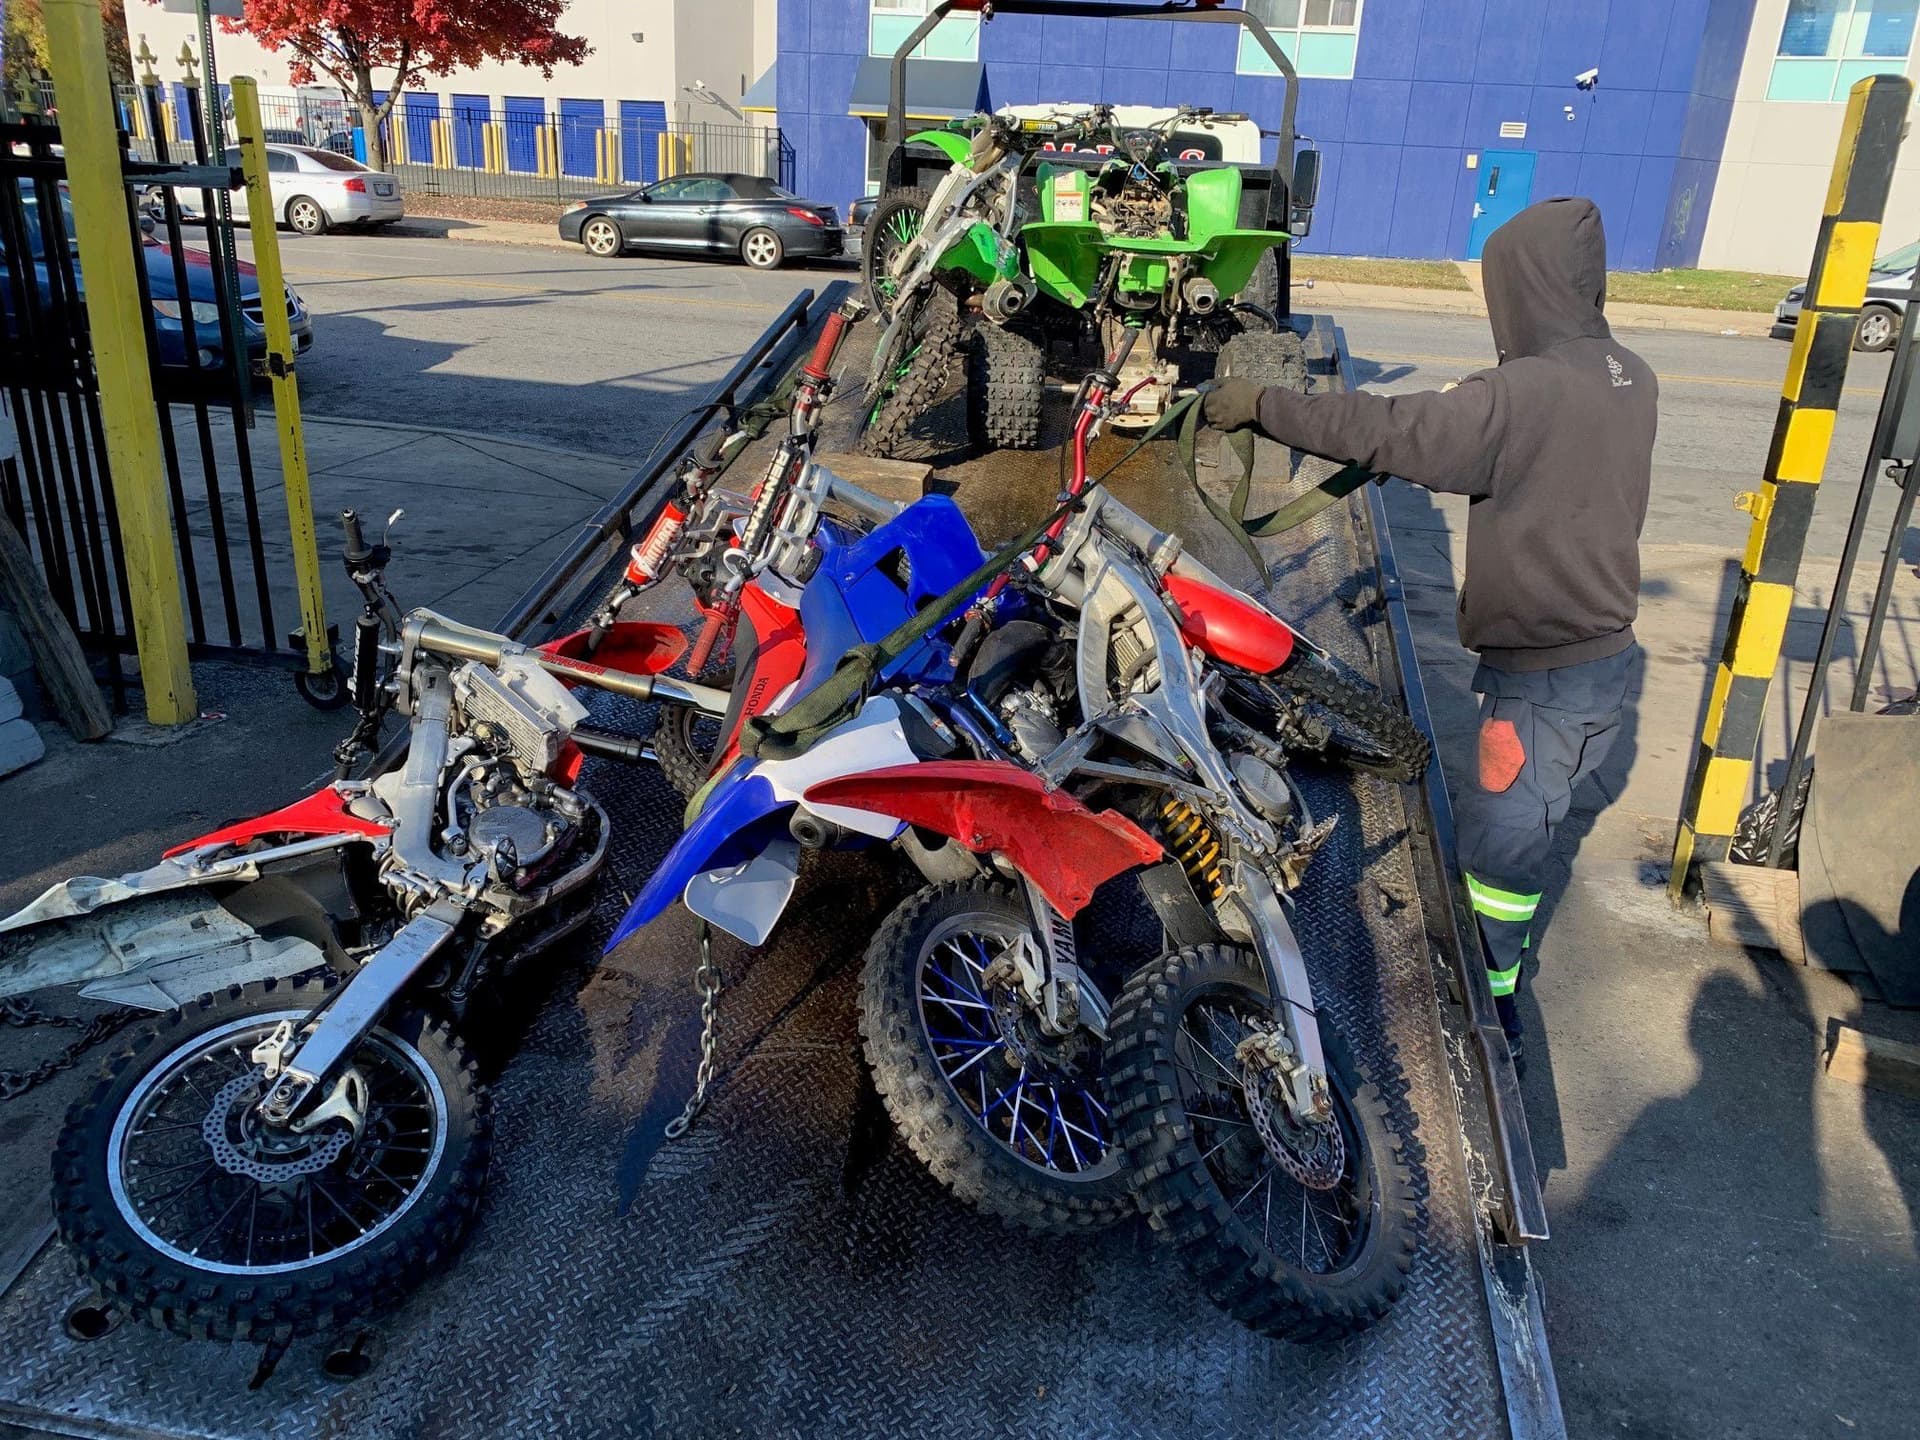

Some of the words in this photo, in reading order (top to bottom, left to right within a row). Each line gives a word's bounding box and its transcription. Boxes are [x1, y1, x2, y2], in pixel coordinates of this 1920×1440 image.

[742, 450, 791, 544] RENTHAL
[745, 676, 769, 717] HONDA
[1050, 907, 1077, 964] YAM
